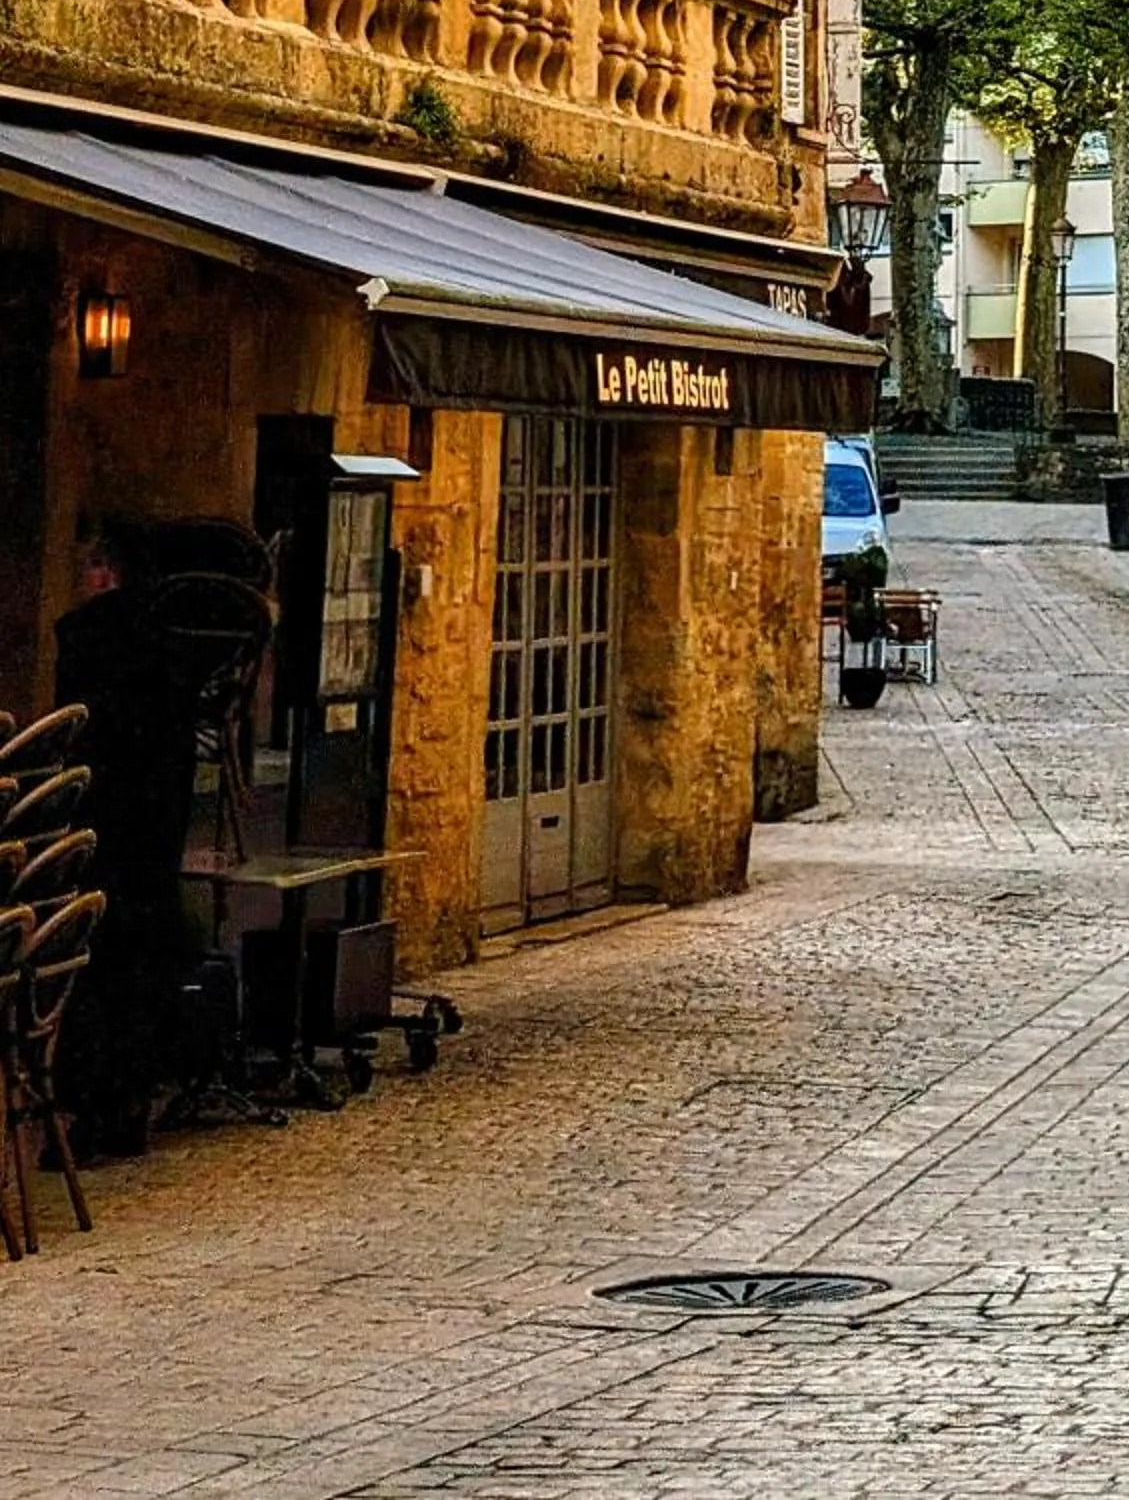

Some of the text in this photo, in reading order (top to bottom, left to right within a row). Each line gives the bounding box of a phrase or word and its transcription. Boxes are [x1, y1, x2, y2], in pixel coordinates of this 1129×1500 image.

[767, 283, 807, 321] TAPAS
[596, 353, 729, 410] Le Petit Bistrot
